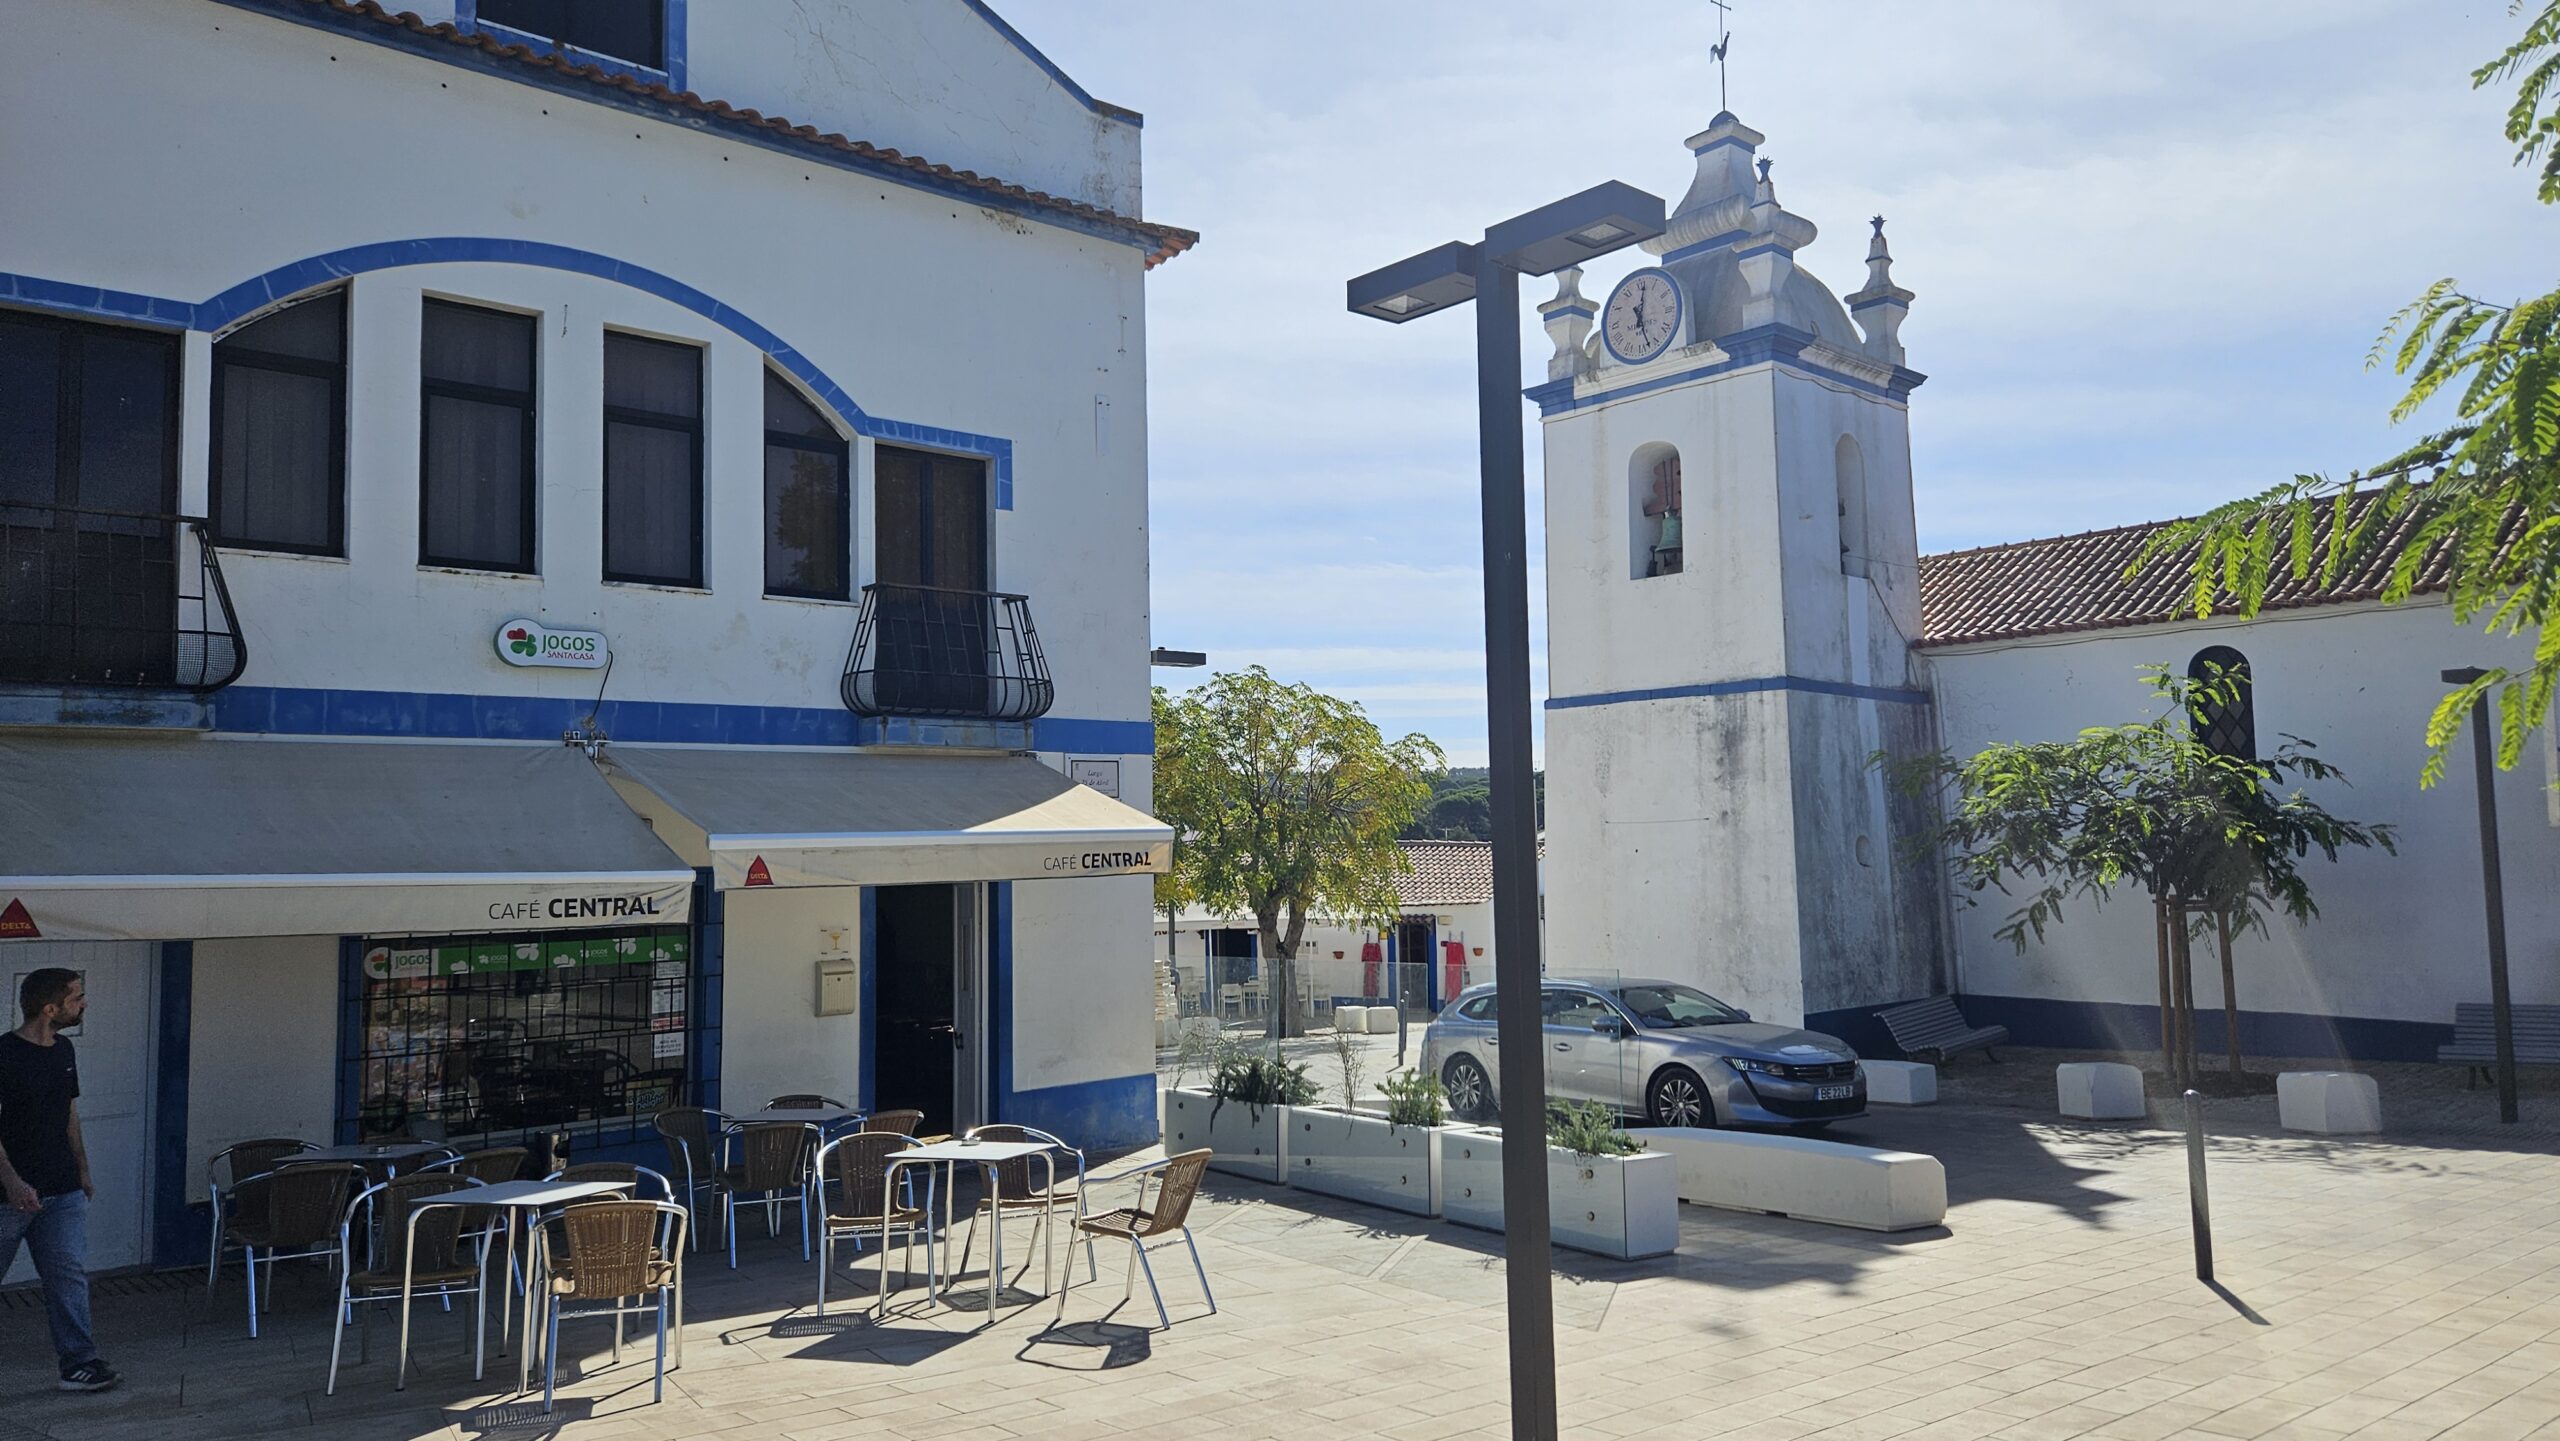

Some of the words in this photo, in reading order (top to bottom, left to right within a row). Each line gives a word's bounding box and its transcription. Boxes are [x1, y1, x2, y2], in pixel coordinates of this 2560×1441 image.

[541, 634, 595, 653] JOGOS
[1043, 854, 1077, 870] CAFÉ
[1081, 851, 1151, 869] CENTRAL
[489, 899, 541, 919] CAFÉ
[548, 896, 660, 918] CENTRAL
[1, 922, 31, 930] DELTA
[395, 954, 432, 969] JOGOS
